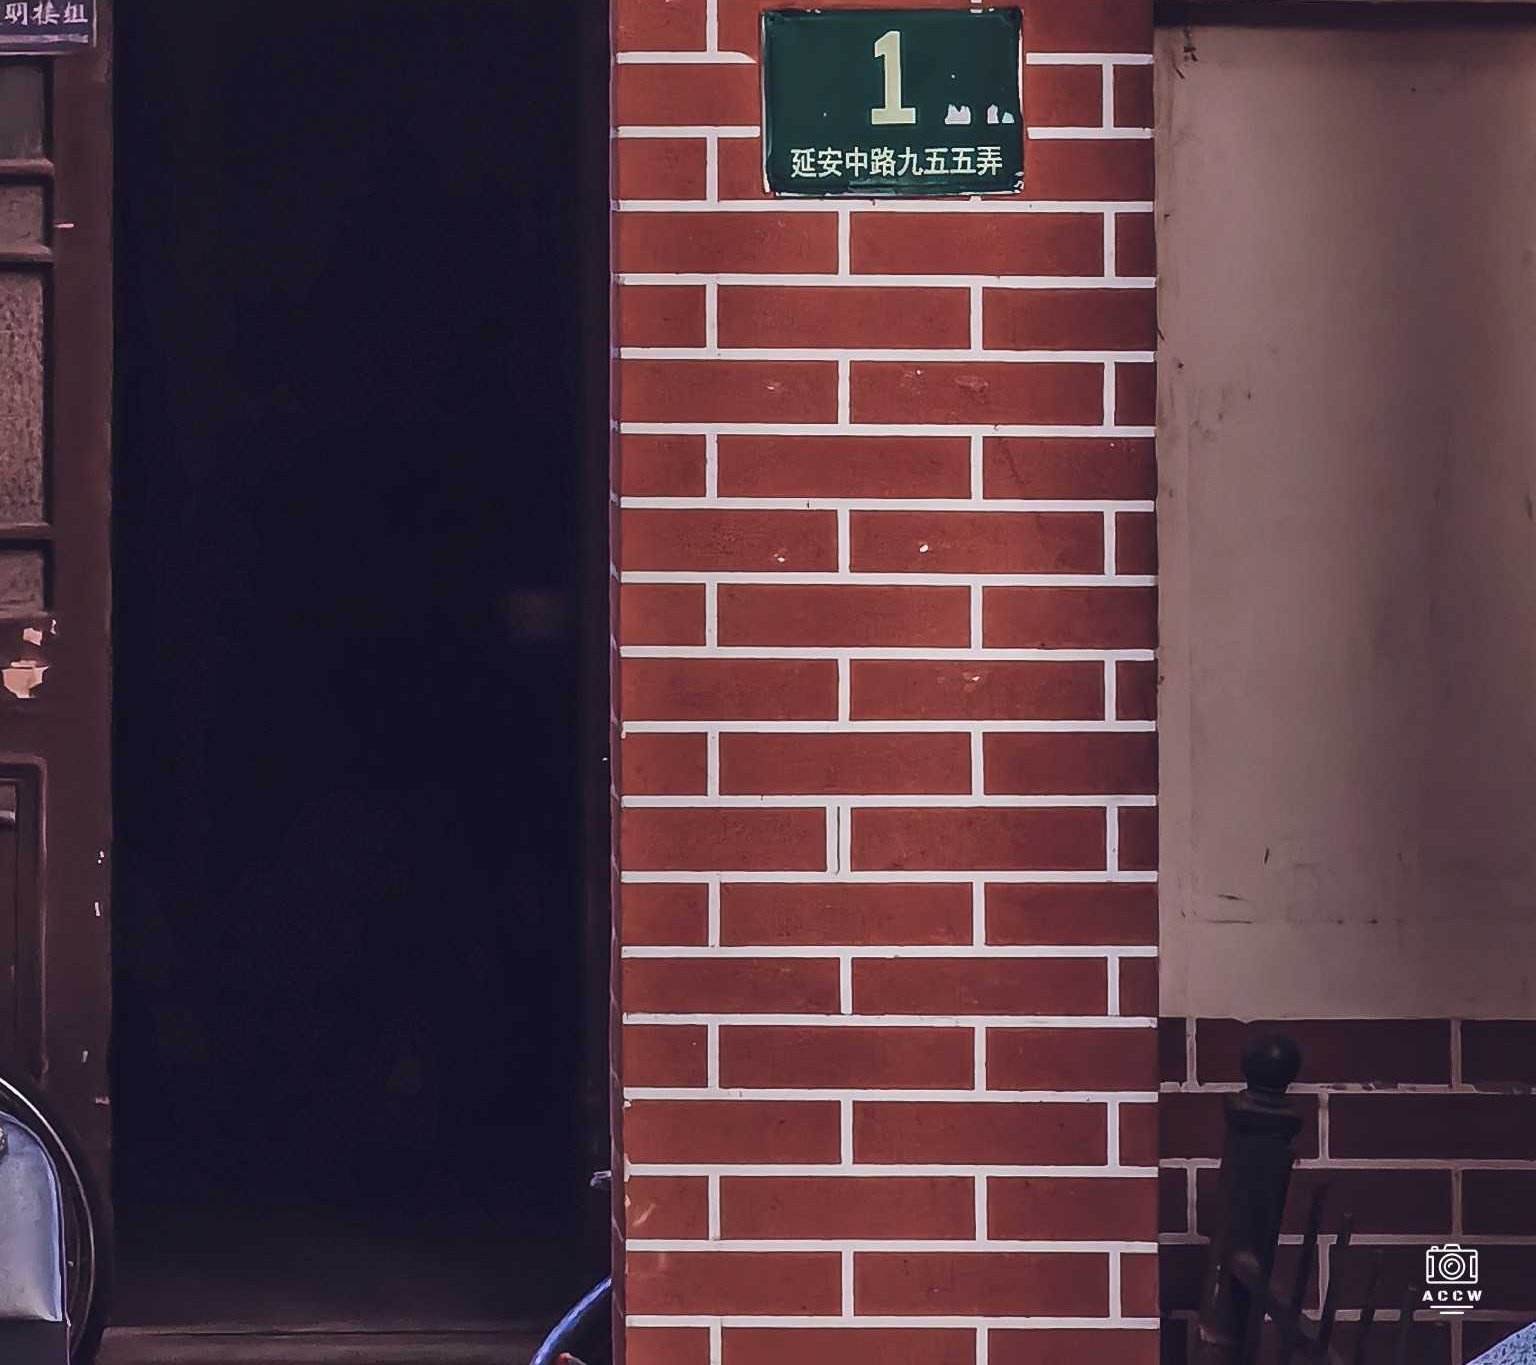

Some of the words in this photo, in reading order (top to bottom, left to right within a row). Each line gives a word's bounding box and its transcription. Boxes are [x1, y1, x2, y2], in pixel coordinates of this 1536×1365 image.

[871, 30, 916, 125] 1
[790, 146, 1003, 178] 延安中路九五五弄
